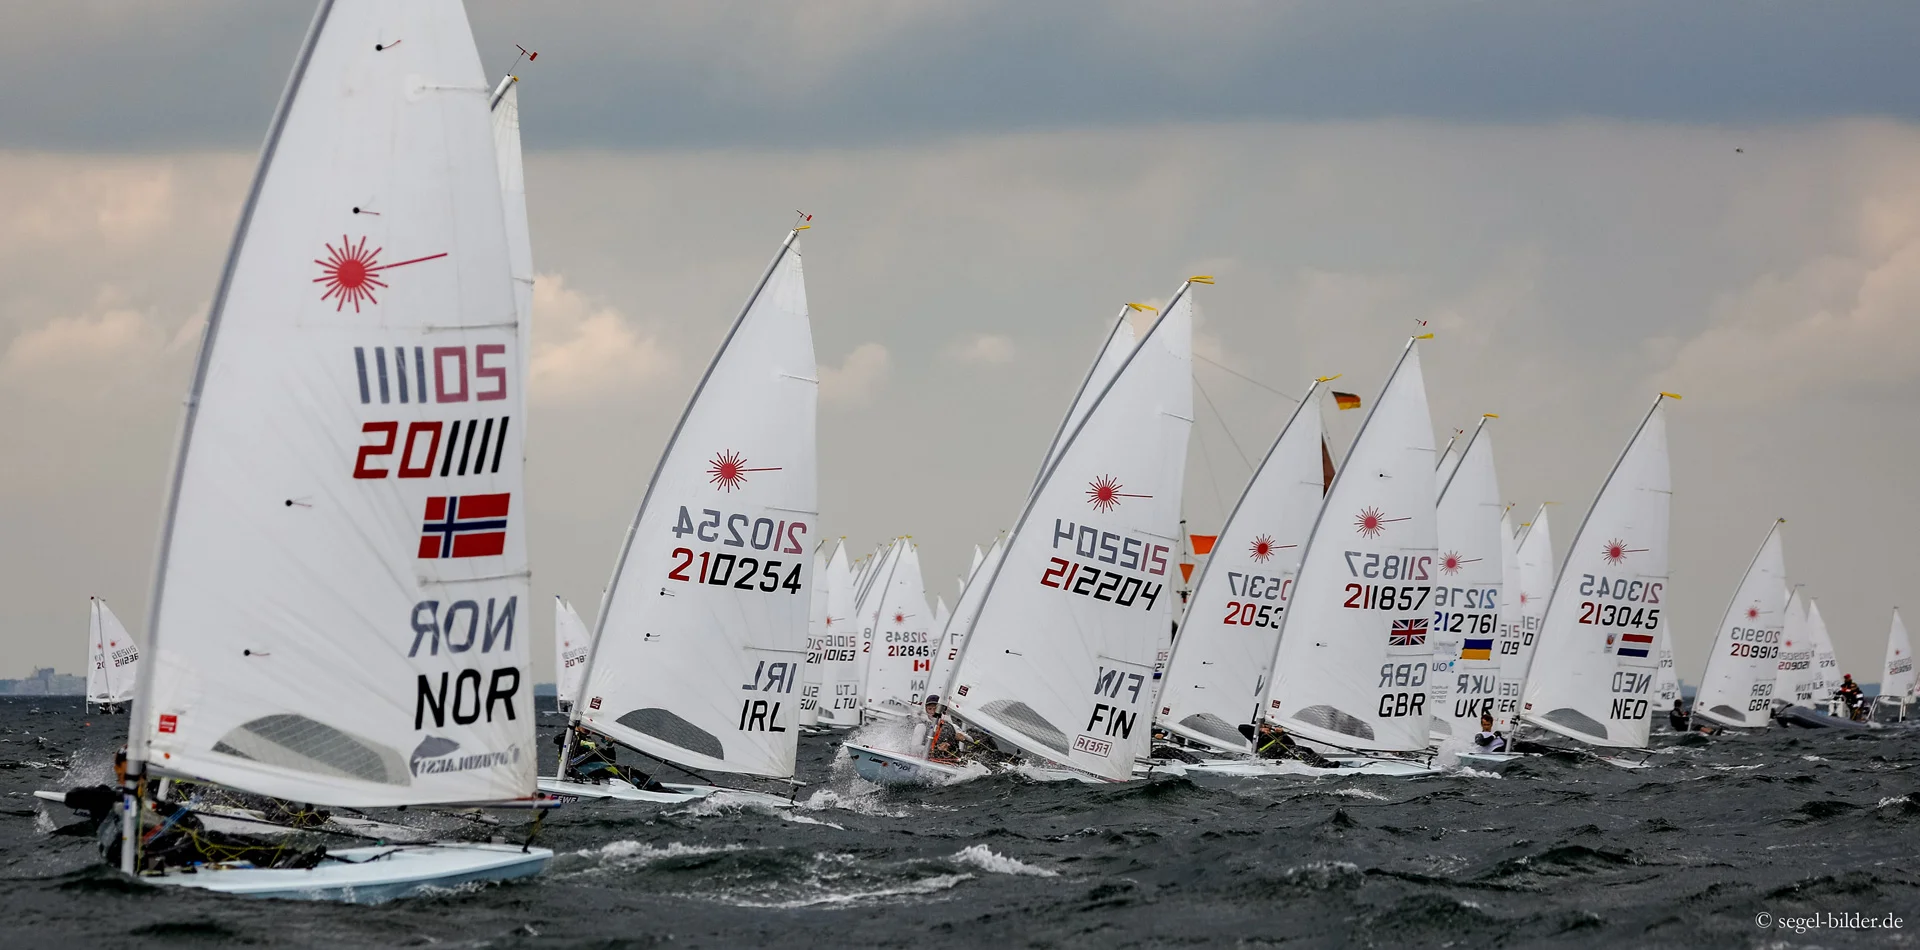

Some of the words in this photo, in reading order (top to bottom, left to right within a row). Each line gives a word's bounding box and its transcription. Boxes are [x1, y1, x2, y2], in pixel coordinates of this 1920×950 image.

[353, 416, 510, 479] 201111
[668, 547, 803, 594] 210254
[1040, 556, 1163, 611] 212204
[1343, 583, 1431, 611] 211857
[1579, 601, 1660, 630] 213045
[888, 645, 929, 657] 212845
[1730, 643, 1779, 659] 209913
[414, 667, 521, 730] NOR
[834, 698, 857, 709] LTU
[1378, 692, 1426, 718] GBR
[1455, 697, 1495, 718] UKR
[1610, 698, 1648, 720] NED
[1748, 699, 1771, 711] GBR
[1797, 692, 1813, 700] TUN
[739, 699, 787, 732] IRL
[1086, 703, 1137, 740] FIN
